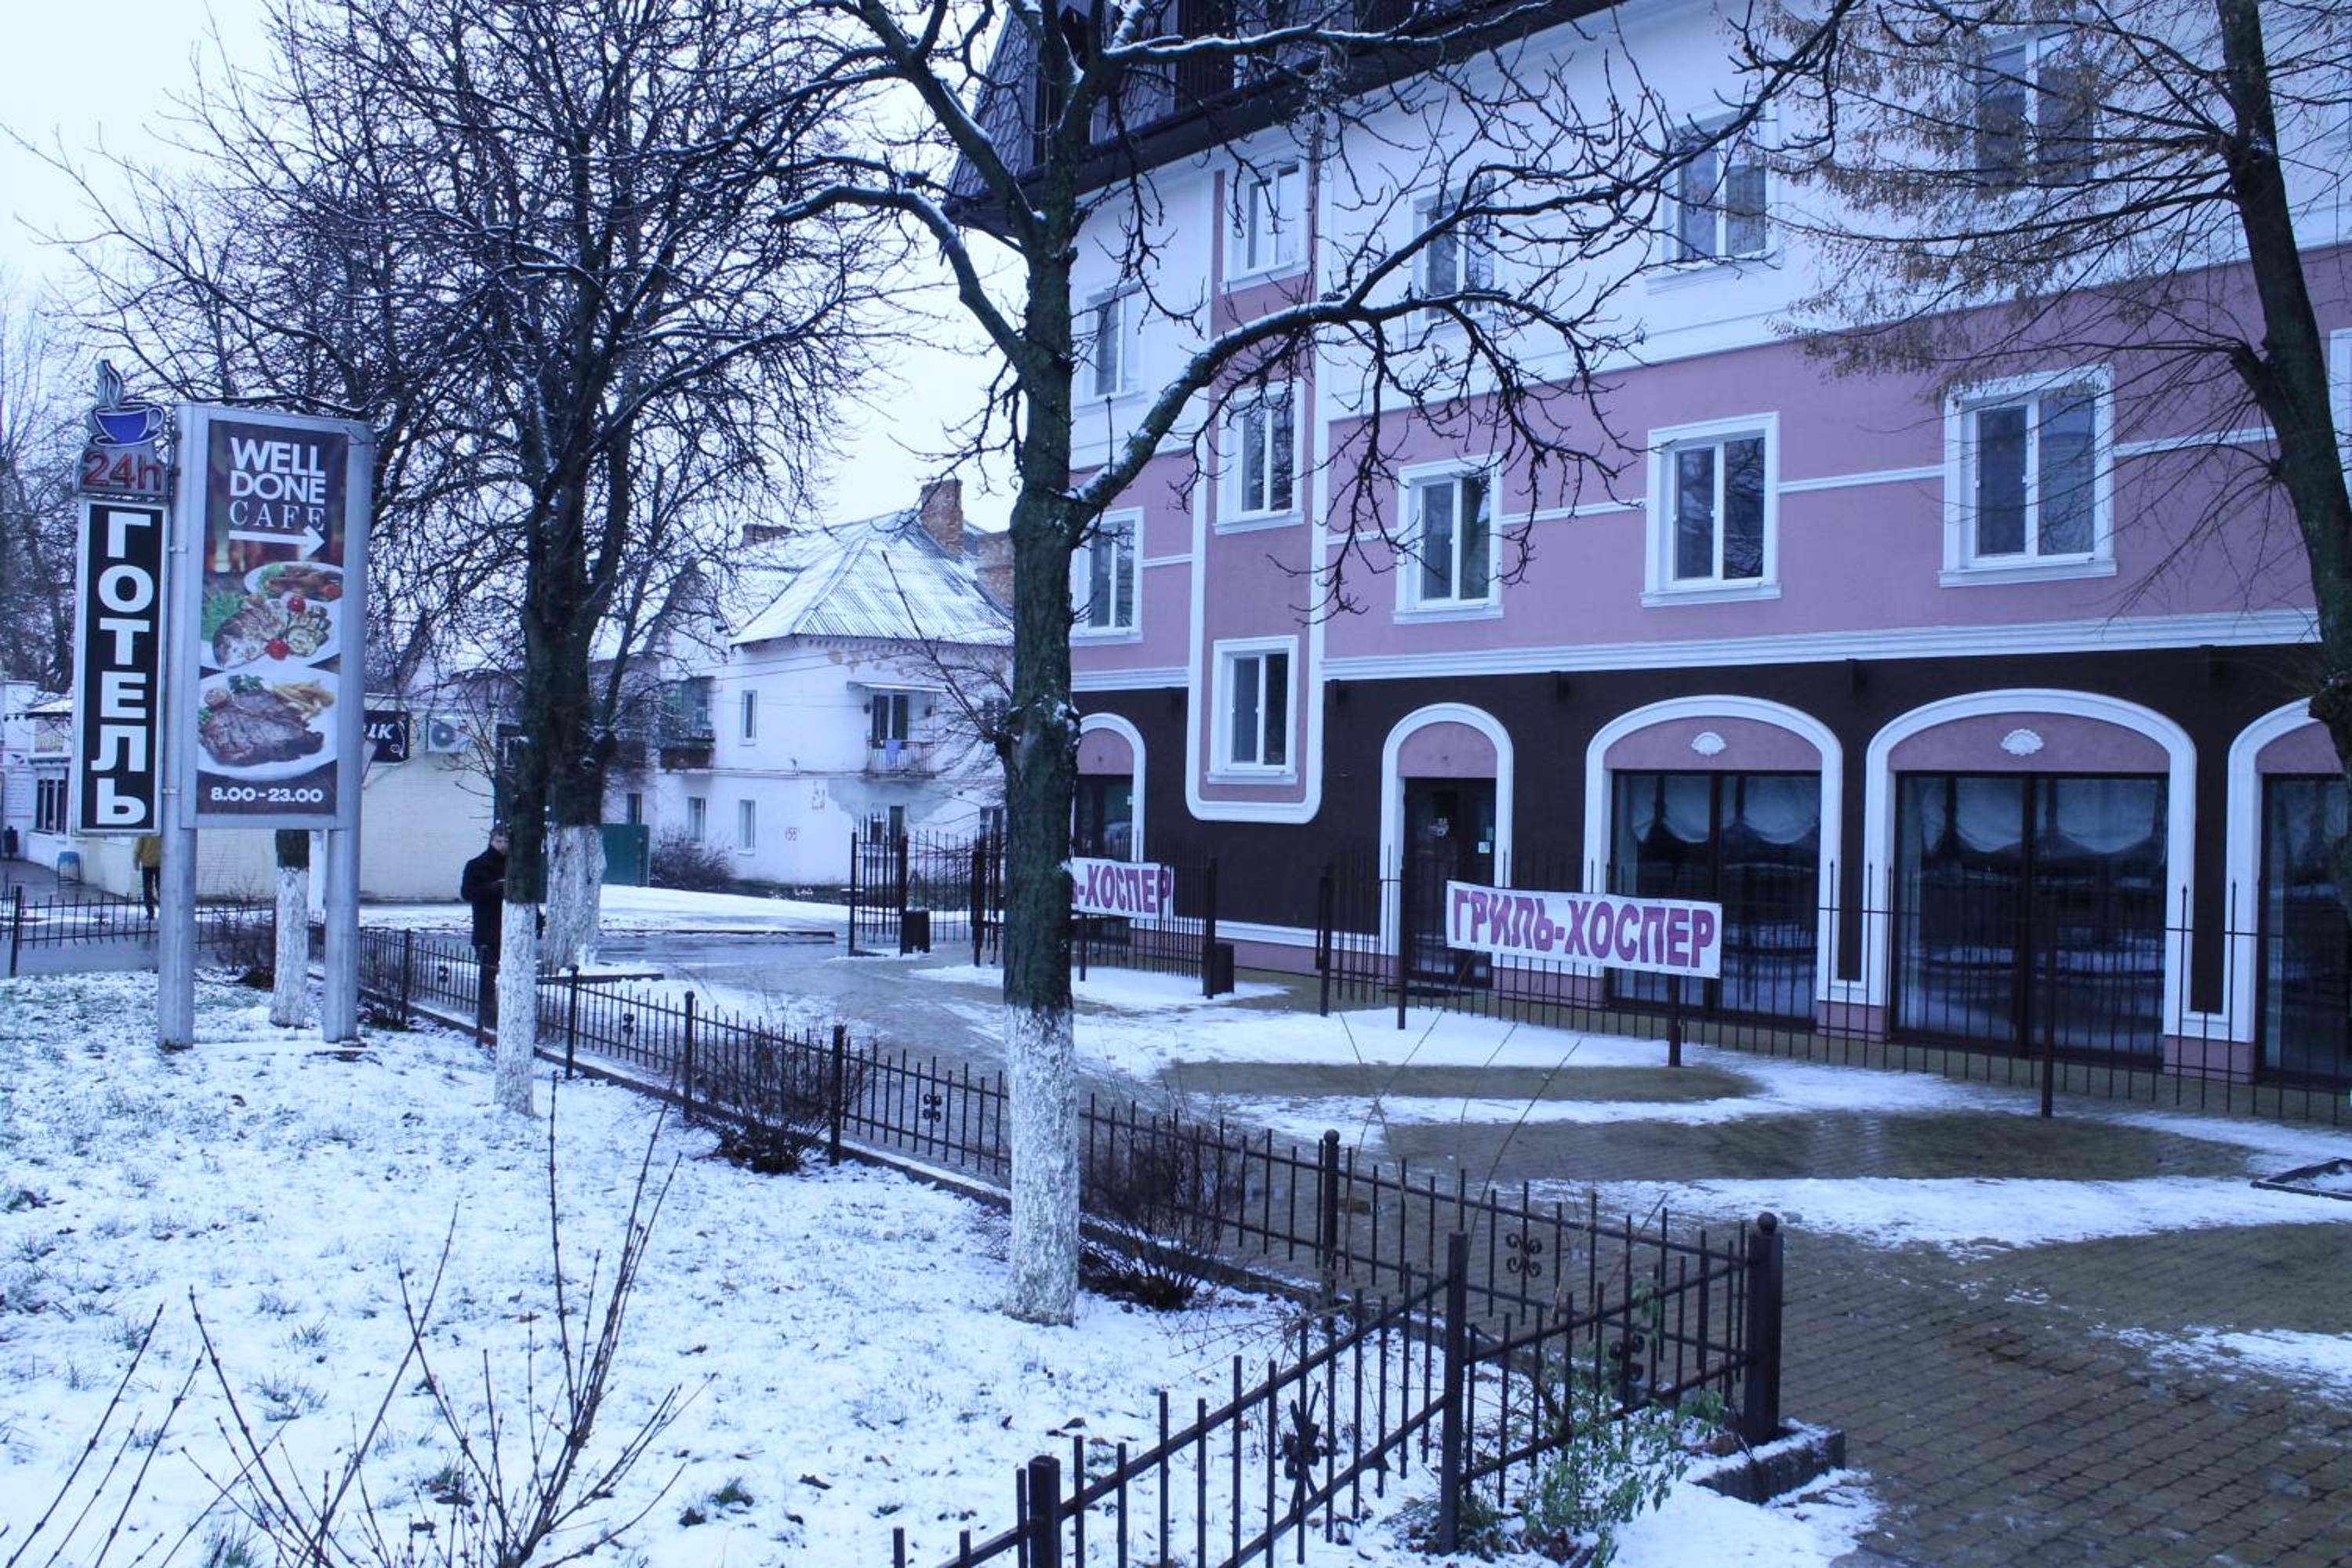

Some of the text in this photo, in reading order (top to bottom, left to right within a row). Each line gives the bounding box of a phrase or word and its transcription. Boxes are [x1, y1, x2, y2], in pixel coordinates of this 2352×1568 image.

[82, 450, 162, 492] 24h
[230, 437, 326, 477] WELL
[230, 470, 326, 504] DONE
[229, 499, 325, 532] CAFE
[90, 510, 154, 826] ГОТЕЛЬ
[1453, 888, 1715, 968] ГРИЛЬ-ХОСПЕР
